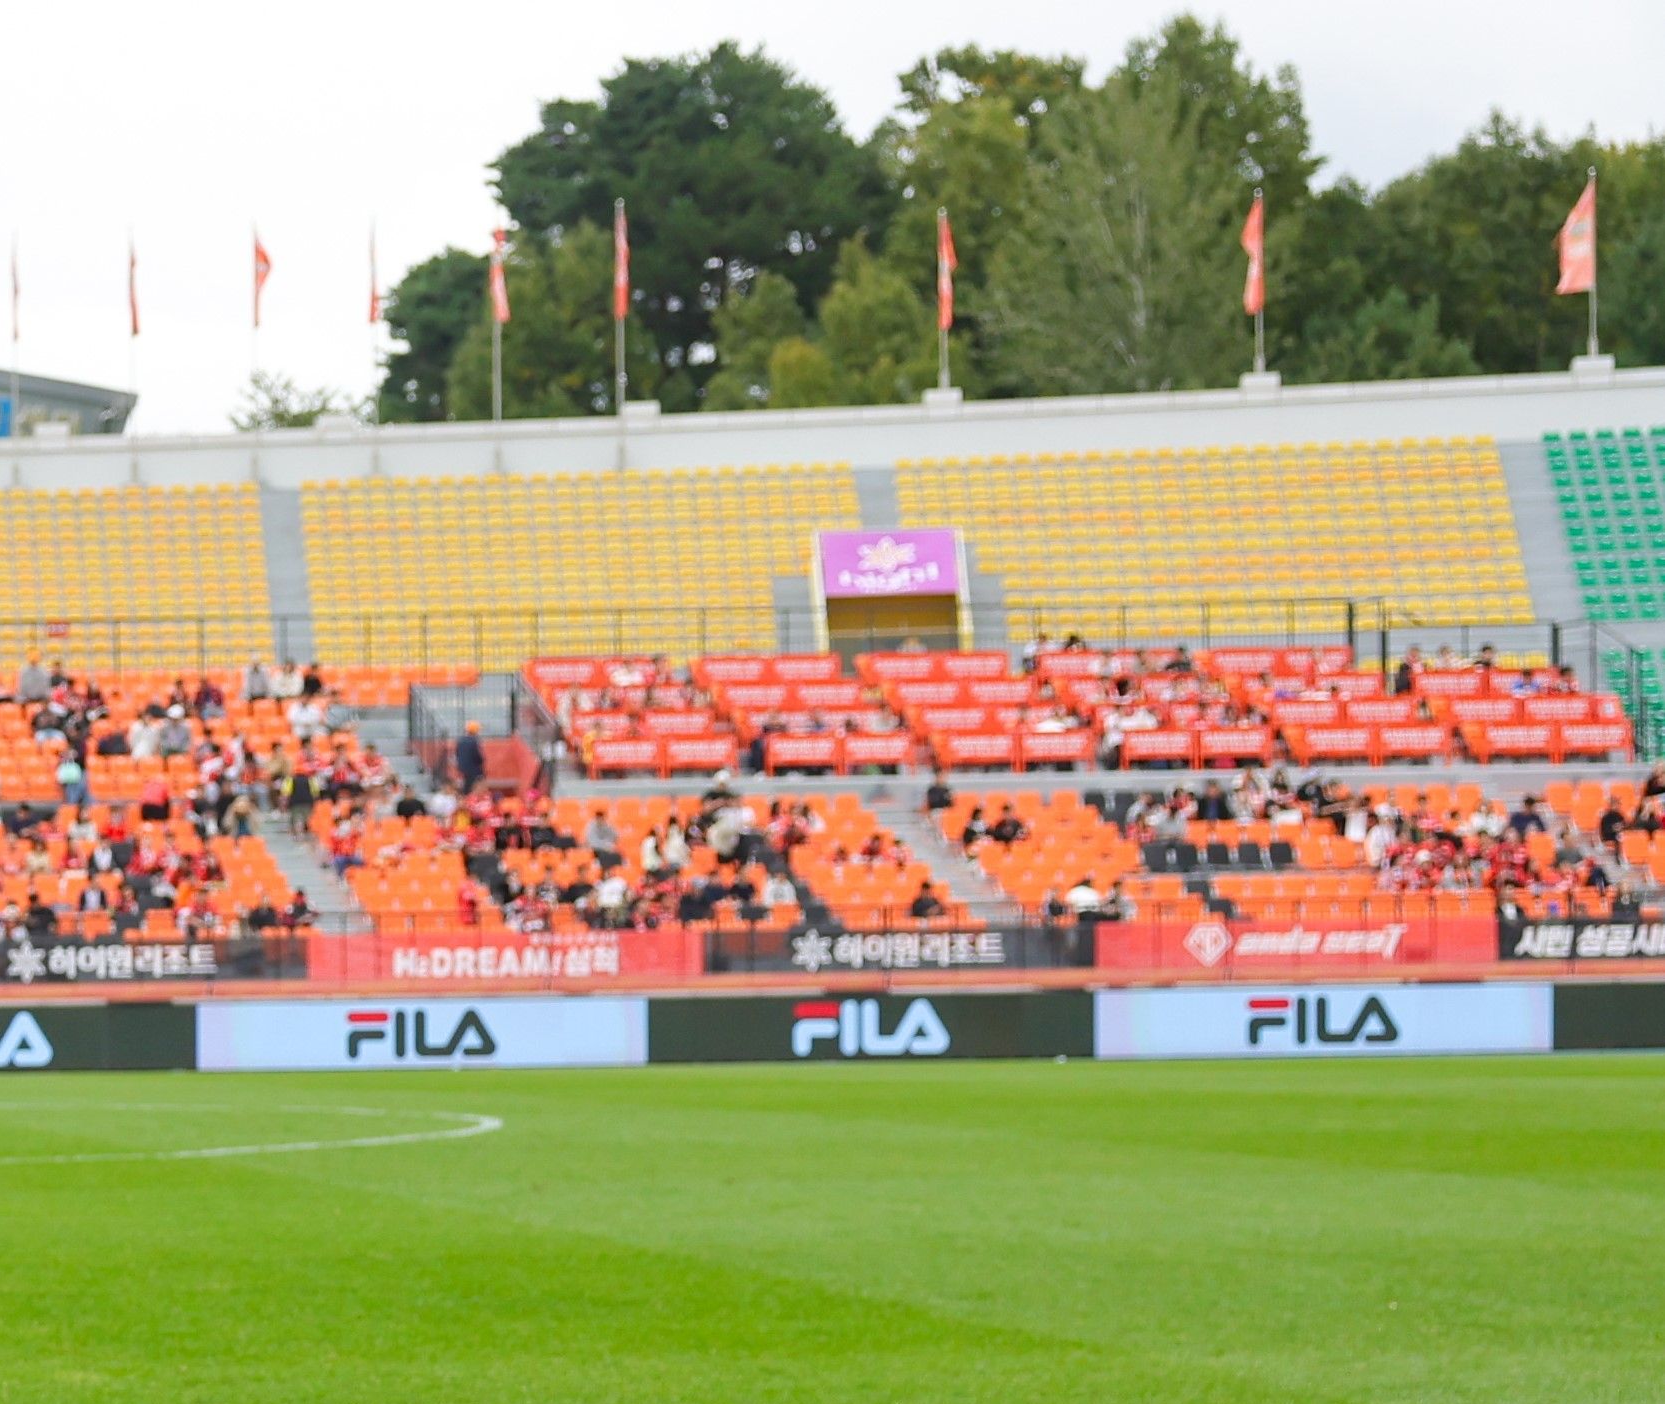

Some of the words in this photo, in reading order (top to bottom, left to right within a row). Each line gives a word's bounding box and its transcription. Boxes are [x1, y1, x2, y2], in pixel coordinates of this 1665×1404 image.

[48, 944, 218, 980] 하이원리조트
[346, 1009, 497, 1059] FILA
[791, 998, 950, 1057] FILA
[1247, 996, 1400, 1046] FILA
